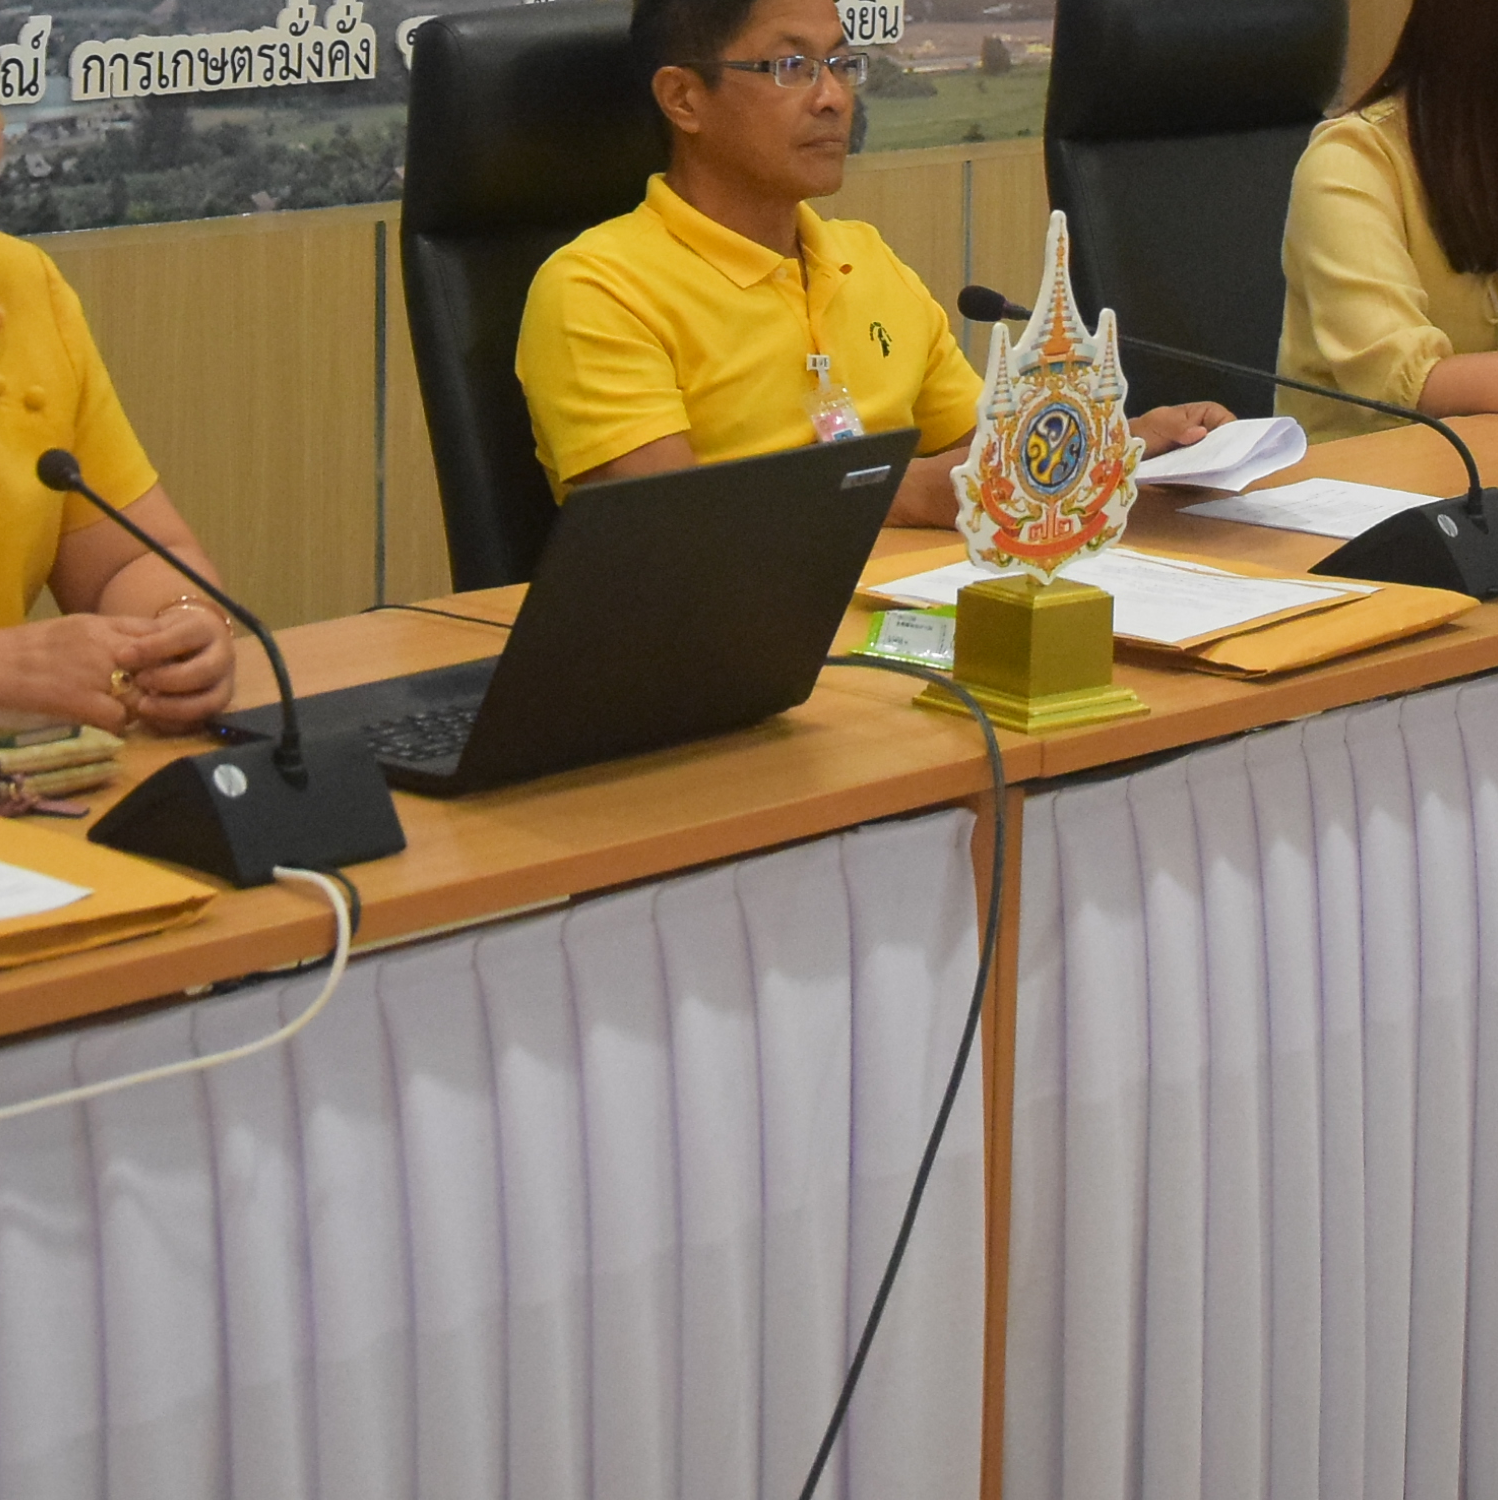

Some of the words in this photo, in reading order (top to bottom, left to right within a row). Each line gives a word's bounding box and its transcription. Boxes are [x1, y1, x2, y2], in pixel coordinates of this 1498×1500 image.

[82, 5, 372, 95] การเกษตรมั่งคั่ง
